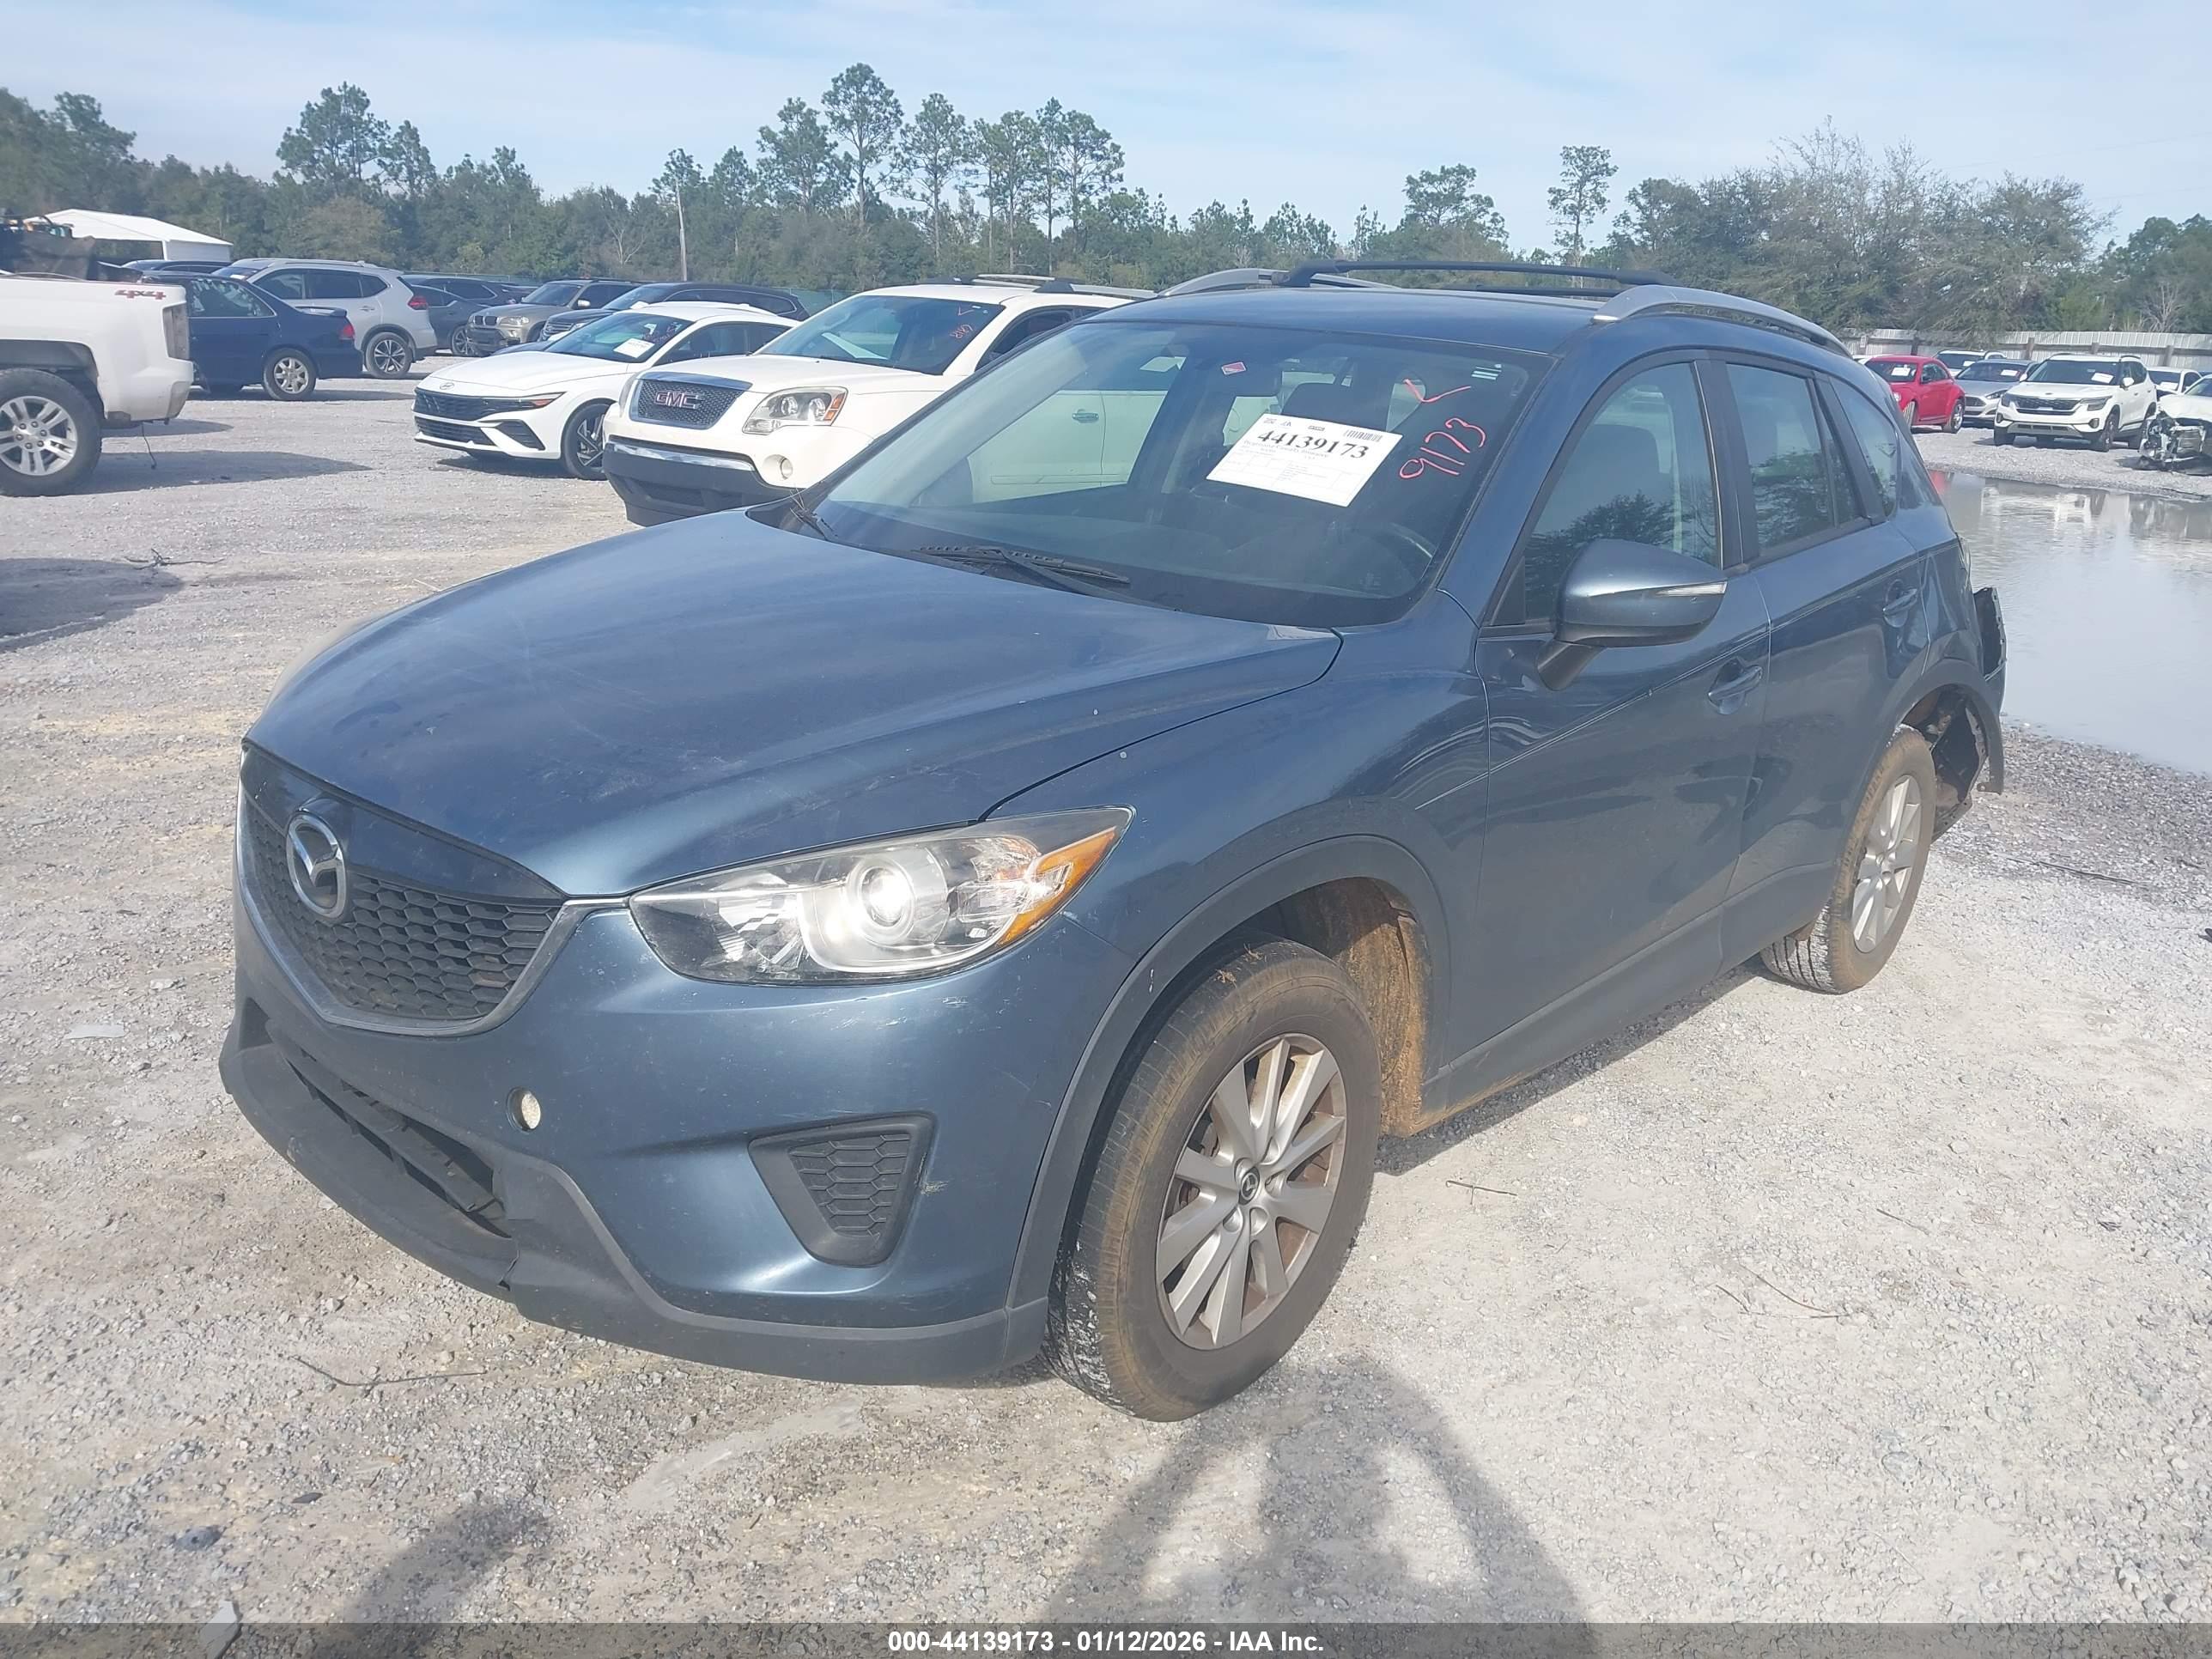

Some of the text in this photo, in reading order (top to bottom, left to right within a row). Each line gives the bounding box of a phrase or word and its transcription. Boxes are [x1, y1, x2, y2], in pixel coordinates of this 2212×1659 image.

[654, 390, 700, 410] GMC
[1257, 429, 1370, 459] 44139173
[1399, 417, 1487, 479] 9173
